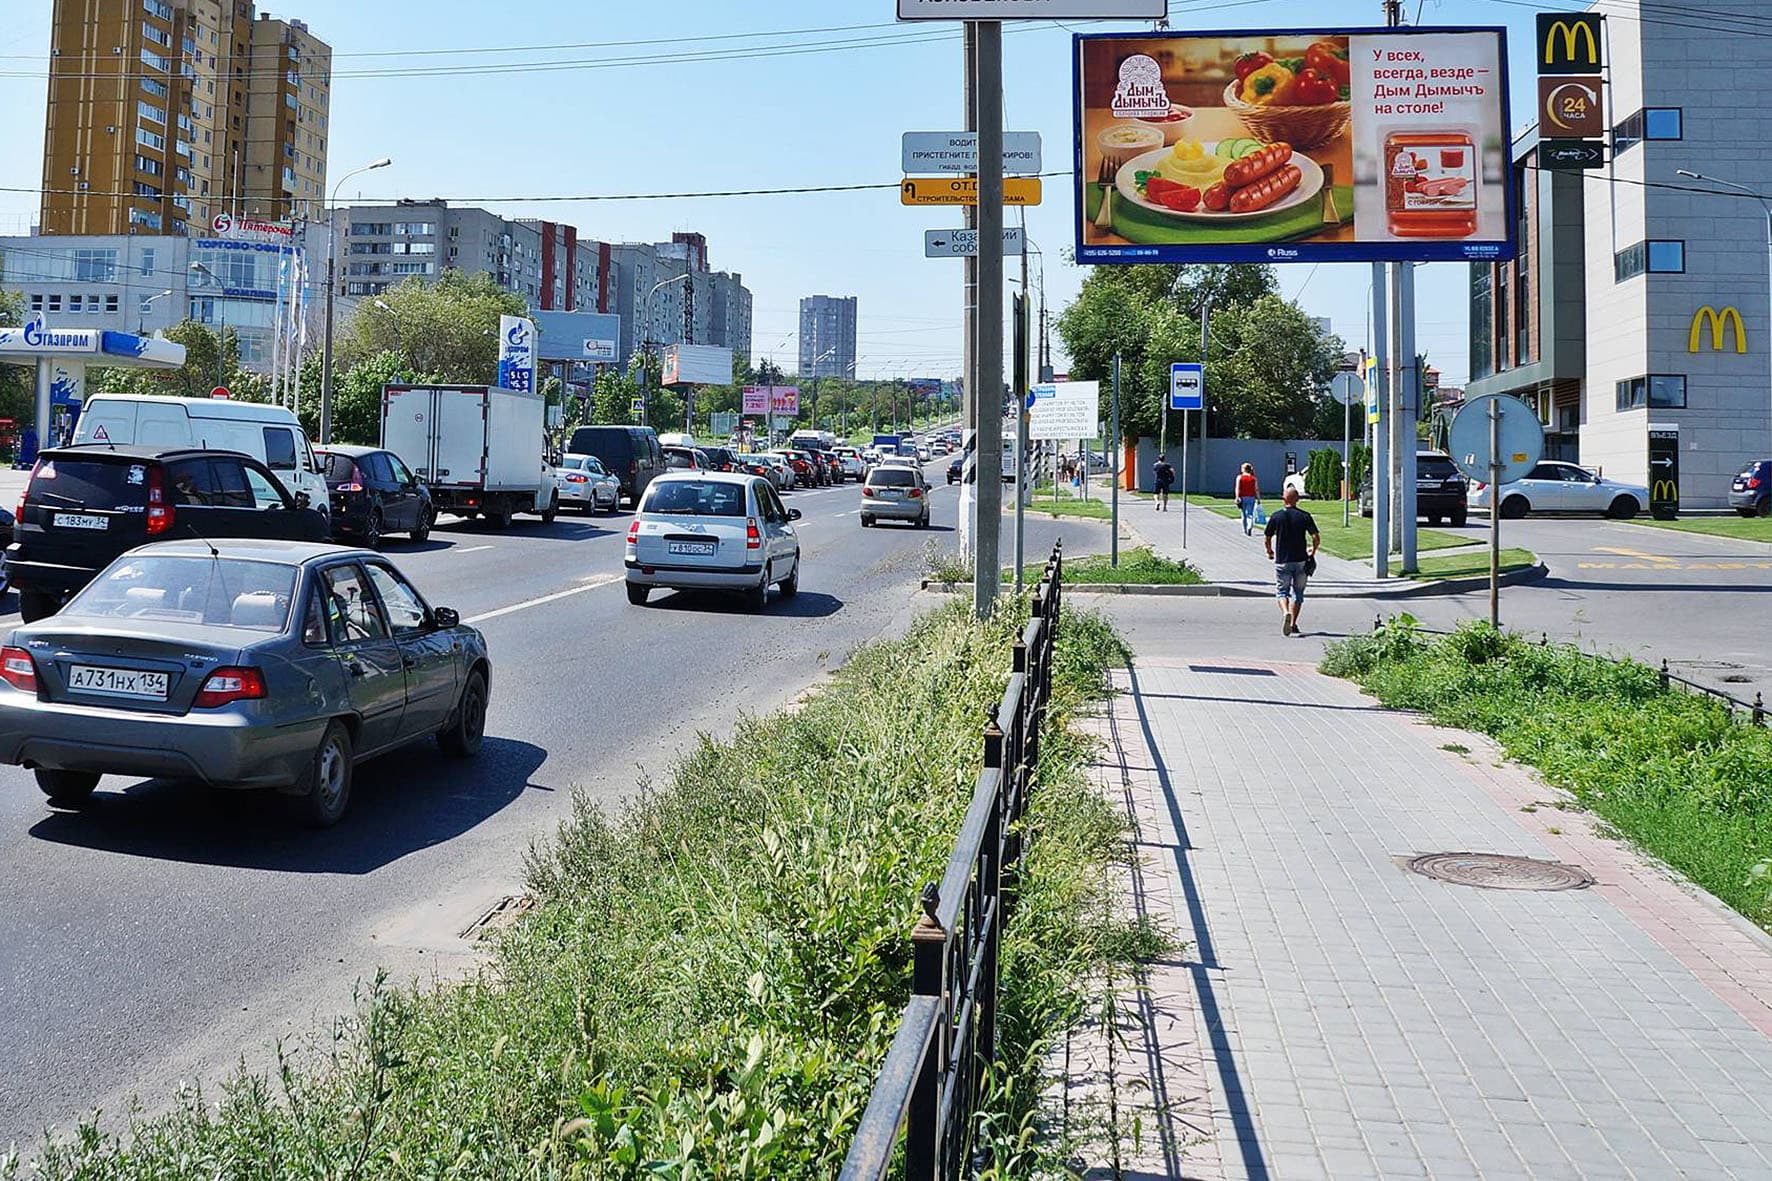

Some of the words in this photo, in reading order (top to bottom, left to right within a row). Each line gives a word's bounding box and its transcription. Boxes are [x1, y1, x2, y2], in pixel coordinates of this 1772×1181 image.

[1373, 49, 1382, 61] У
[1387, 51, 1425, 63] всех,
[1374, 68, 1428, 80] всегда,
[1430, 68, 1474, 80] везде
[1374, 84, 1410, 99] Дым
[1415, 83, 1484, 98] Дымычъ
[1375, 104, 1392, 114] на
[1396, 101, 1444, 114] столе!
[1564, 97, 1586, 112] 24
[949, 139, 977, 147] ВОДИТ
[912, 151, 970, 160] ПРИСТЕГНИТЕ
[43, 334, 89, 347] ГАЗПРОМ
[73, 668, 136, 691] А731НХ
[139, 672, 164, 688] 134
